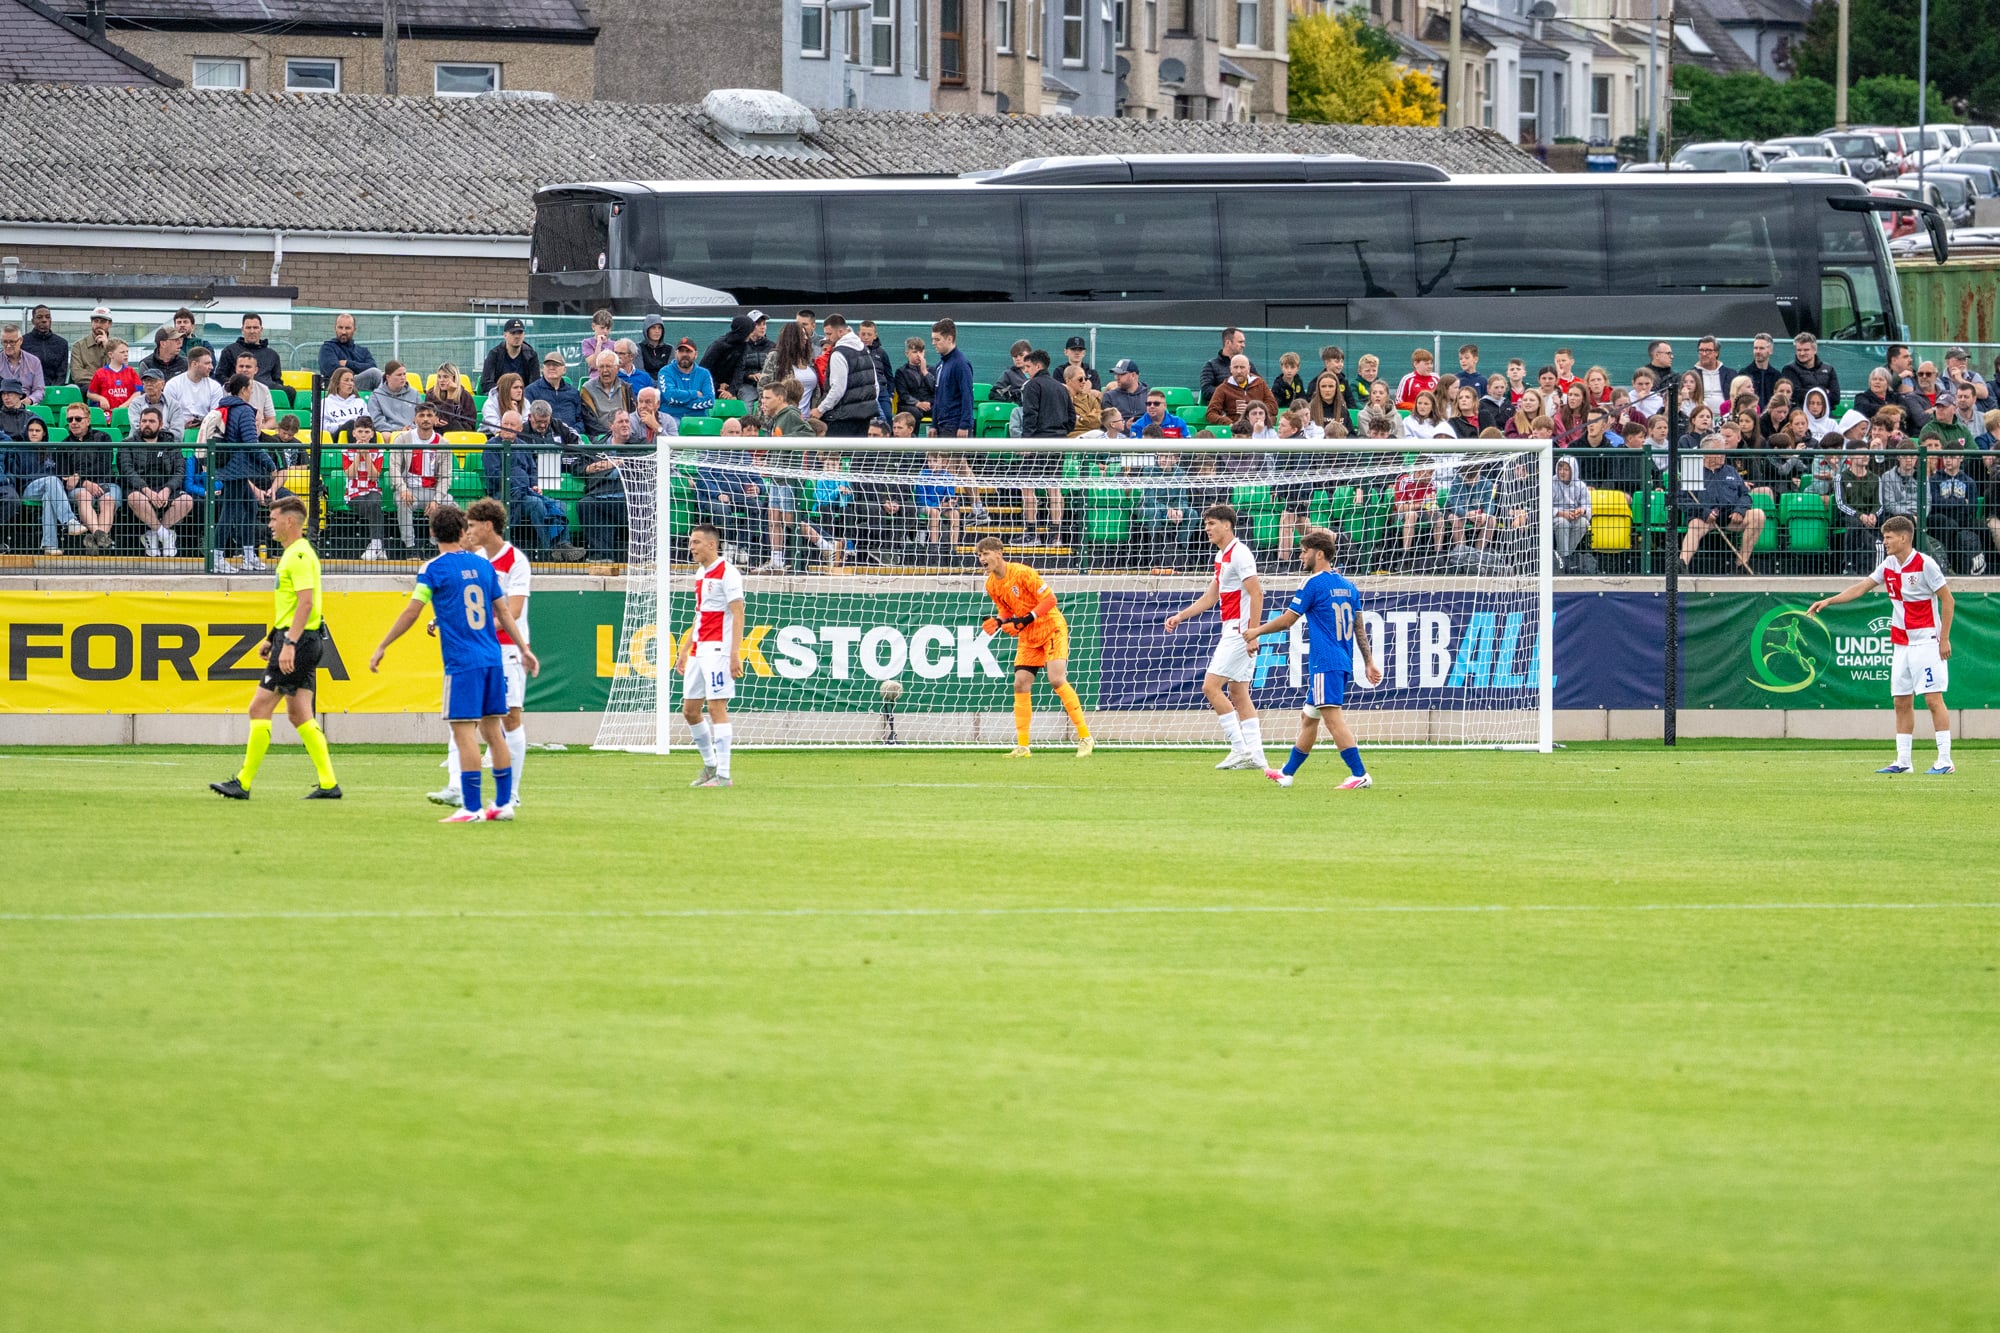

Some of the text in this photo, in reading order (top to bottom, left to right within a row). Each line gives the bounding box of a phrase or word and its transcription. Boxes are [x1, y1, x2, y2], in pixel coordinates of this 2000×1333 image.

[464, 584, 486, 630] 8
[1332, 602, 1353, 641] 10
[1869, 619, 1893, 632] UEF
[1835, 636, 1893, 654] UNDE
[1836, 655, 1894, 666] CHAMPIO
[711, 671, 725, 687] 14
[1851, 670, 1889, 680] WALES
[1925, 667, 1933, 682] 3
